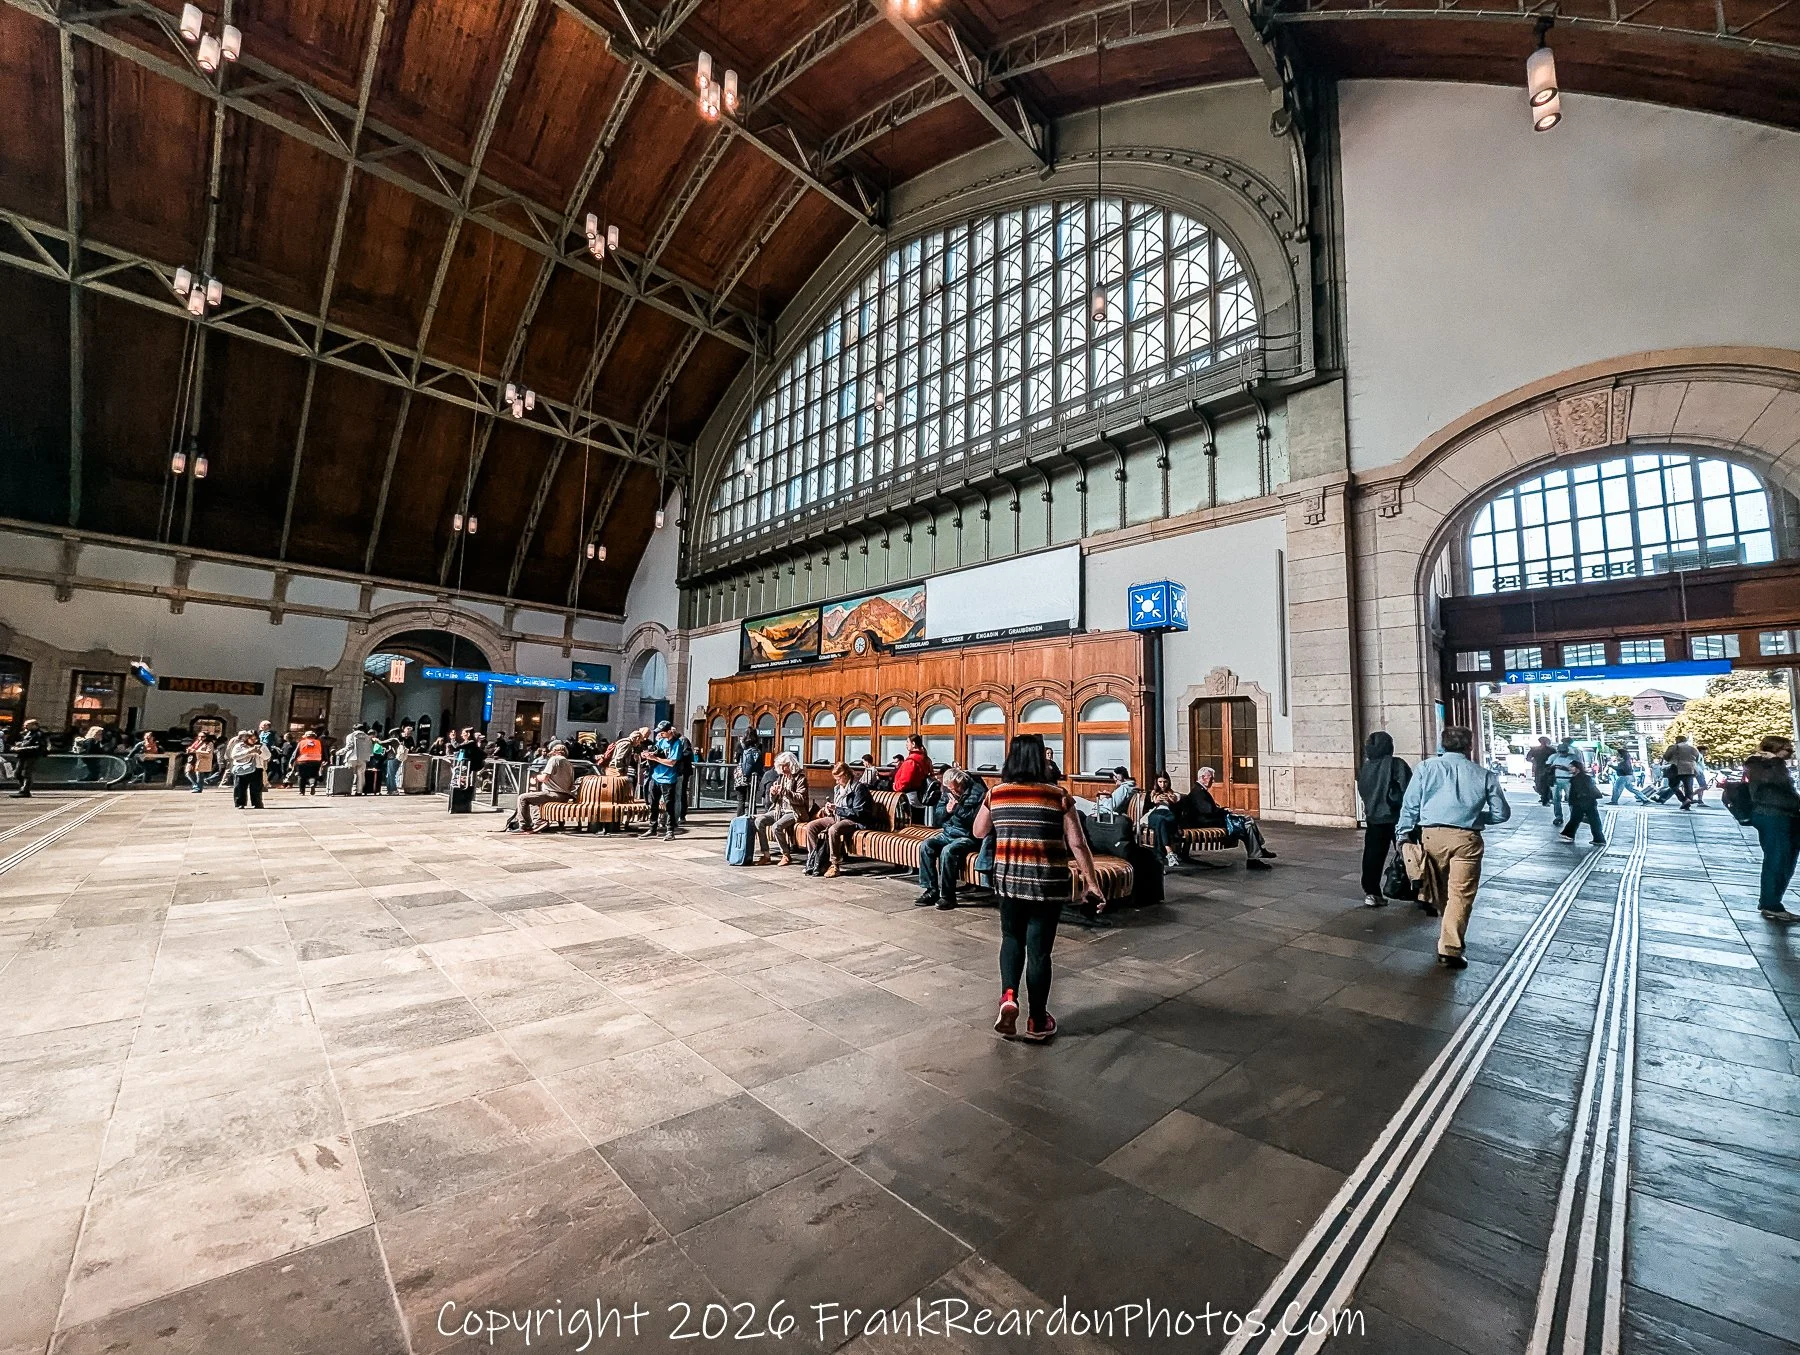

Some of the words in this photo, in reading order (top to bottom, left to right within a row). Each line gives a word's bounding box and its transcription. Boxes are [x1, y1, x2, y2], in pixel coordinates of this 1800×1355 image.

[975, 631, 999, 639] ENGADIN
[1008, 625, 1043, 635] GRAUBÜNDEN
[169, 678, 256, 694] MIGROS
